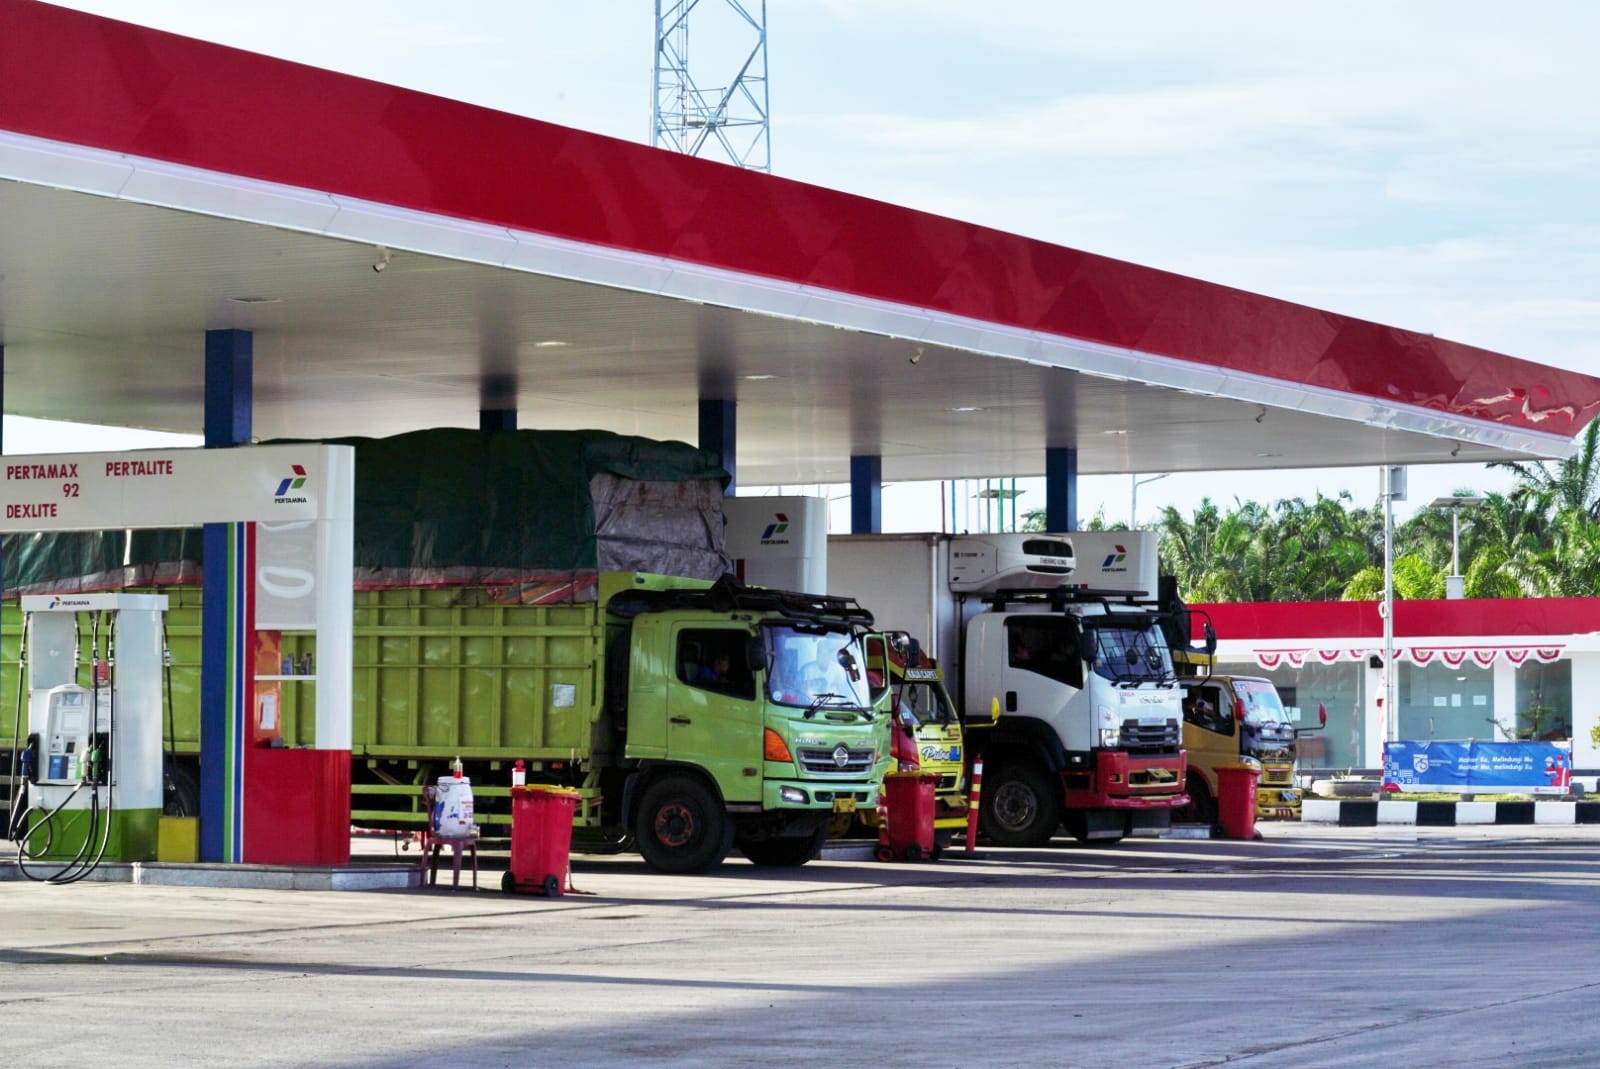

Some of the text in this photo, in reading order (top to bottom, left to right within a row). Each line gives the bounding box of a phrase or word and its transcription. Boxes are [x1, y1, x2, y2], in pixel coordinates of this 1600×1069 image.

[7, 464, 78, 480] PERTAMAX
[105, 460, 173, 477] PERTALITE
[63, 483, 80, 498] 92
[6, 503, 57, 519] DEXLITE
